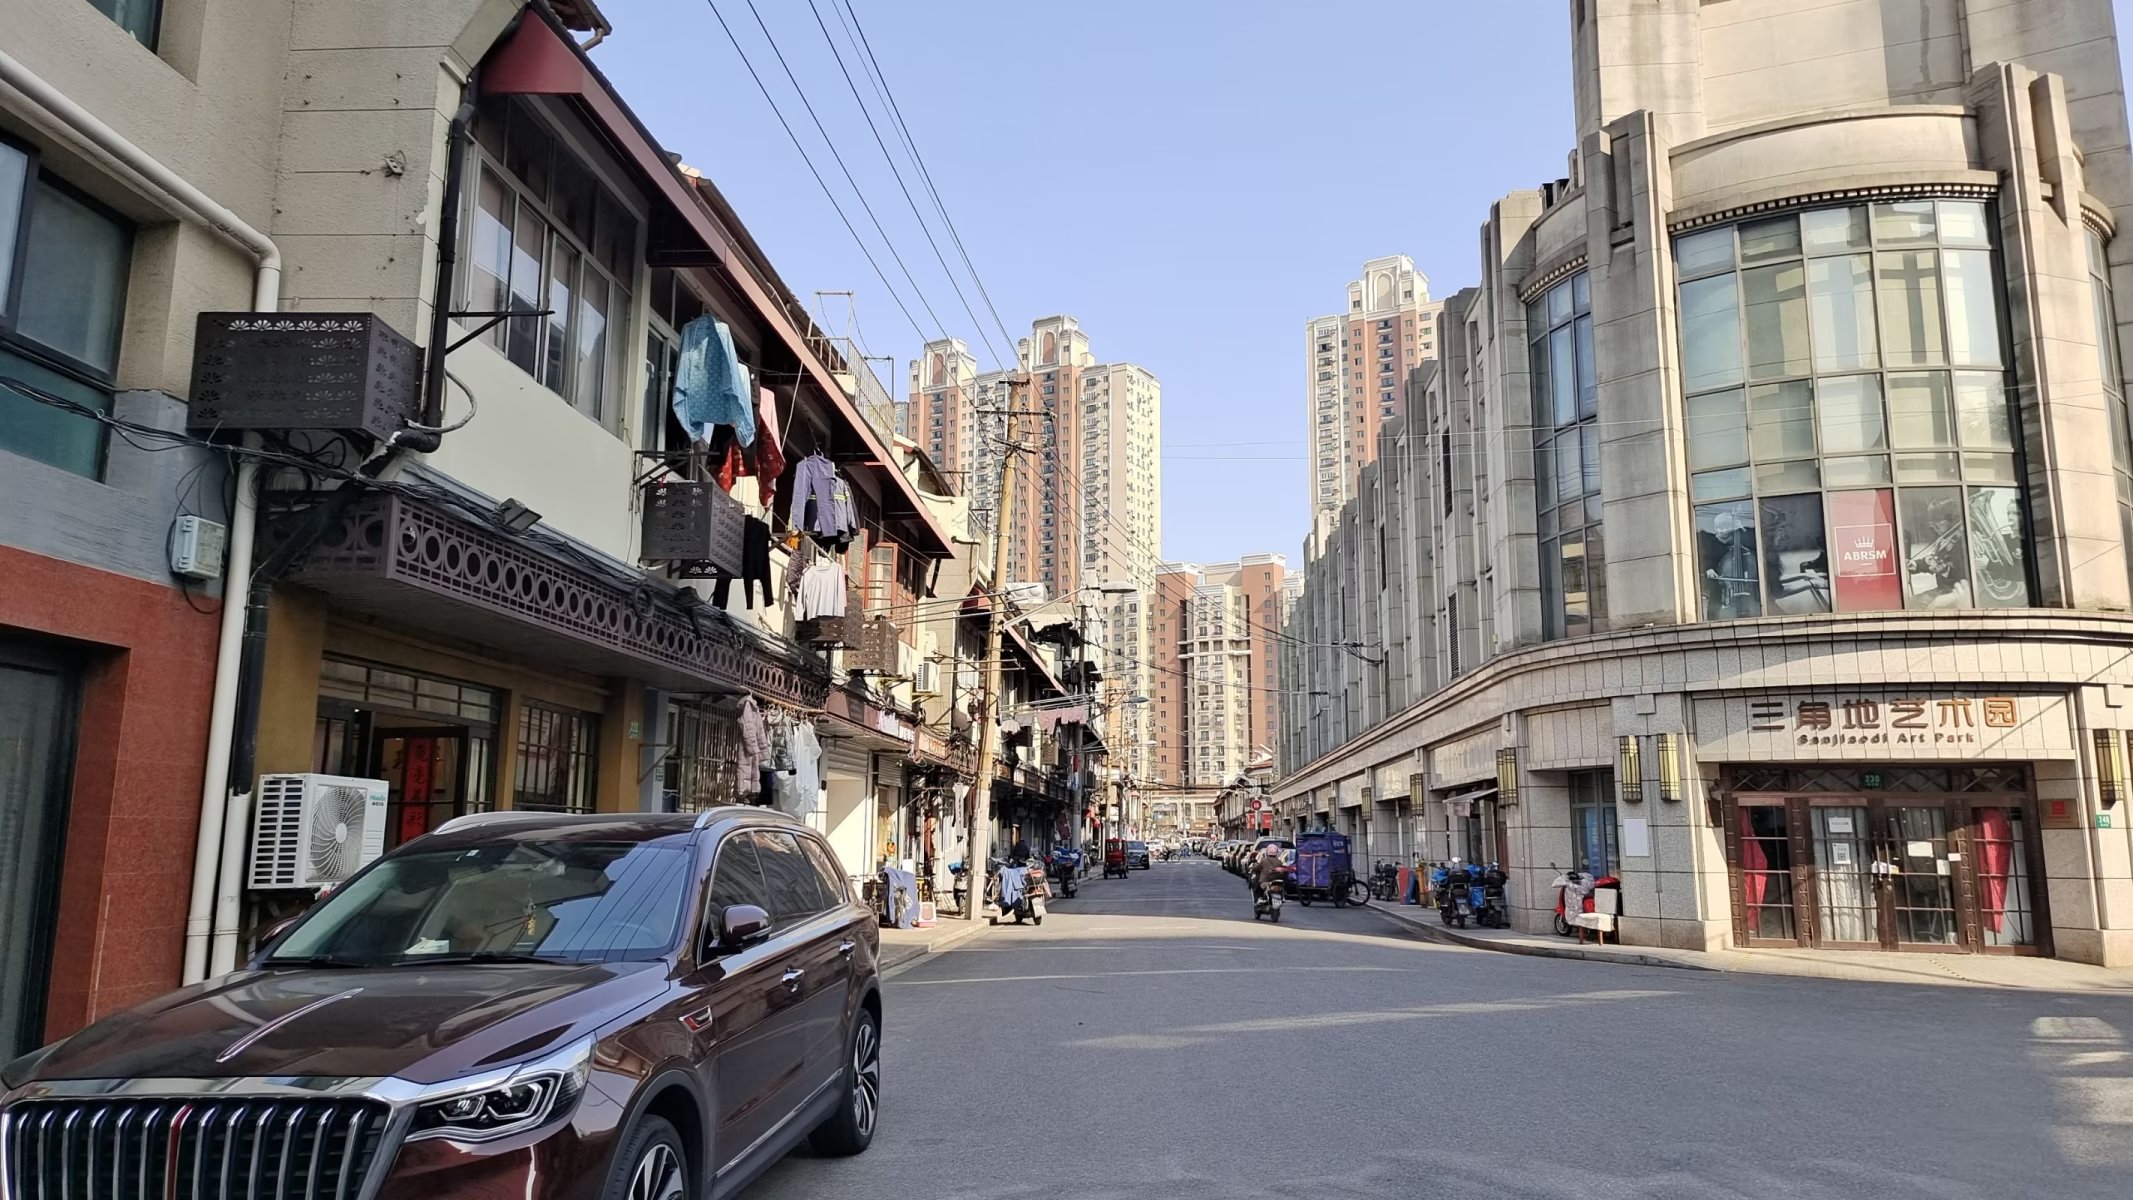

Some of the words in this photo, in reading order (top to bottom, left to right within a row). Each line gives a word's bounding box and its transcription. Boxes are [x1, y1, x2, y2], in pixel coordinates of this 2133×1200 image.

[1844, 550, 1887, 561] ABRSM
[1752, 697, 2018, 731] 三角地艺术园
[1797, 733, 1888, 747] Sanjiaodi
[1897, 733, 1925, 743] Art
[1935, 732, 1974, 743] Park
